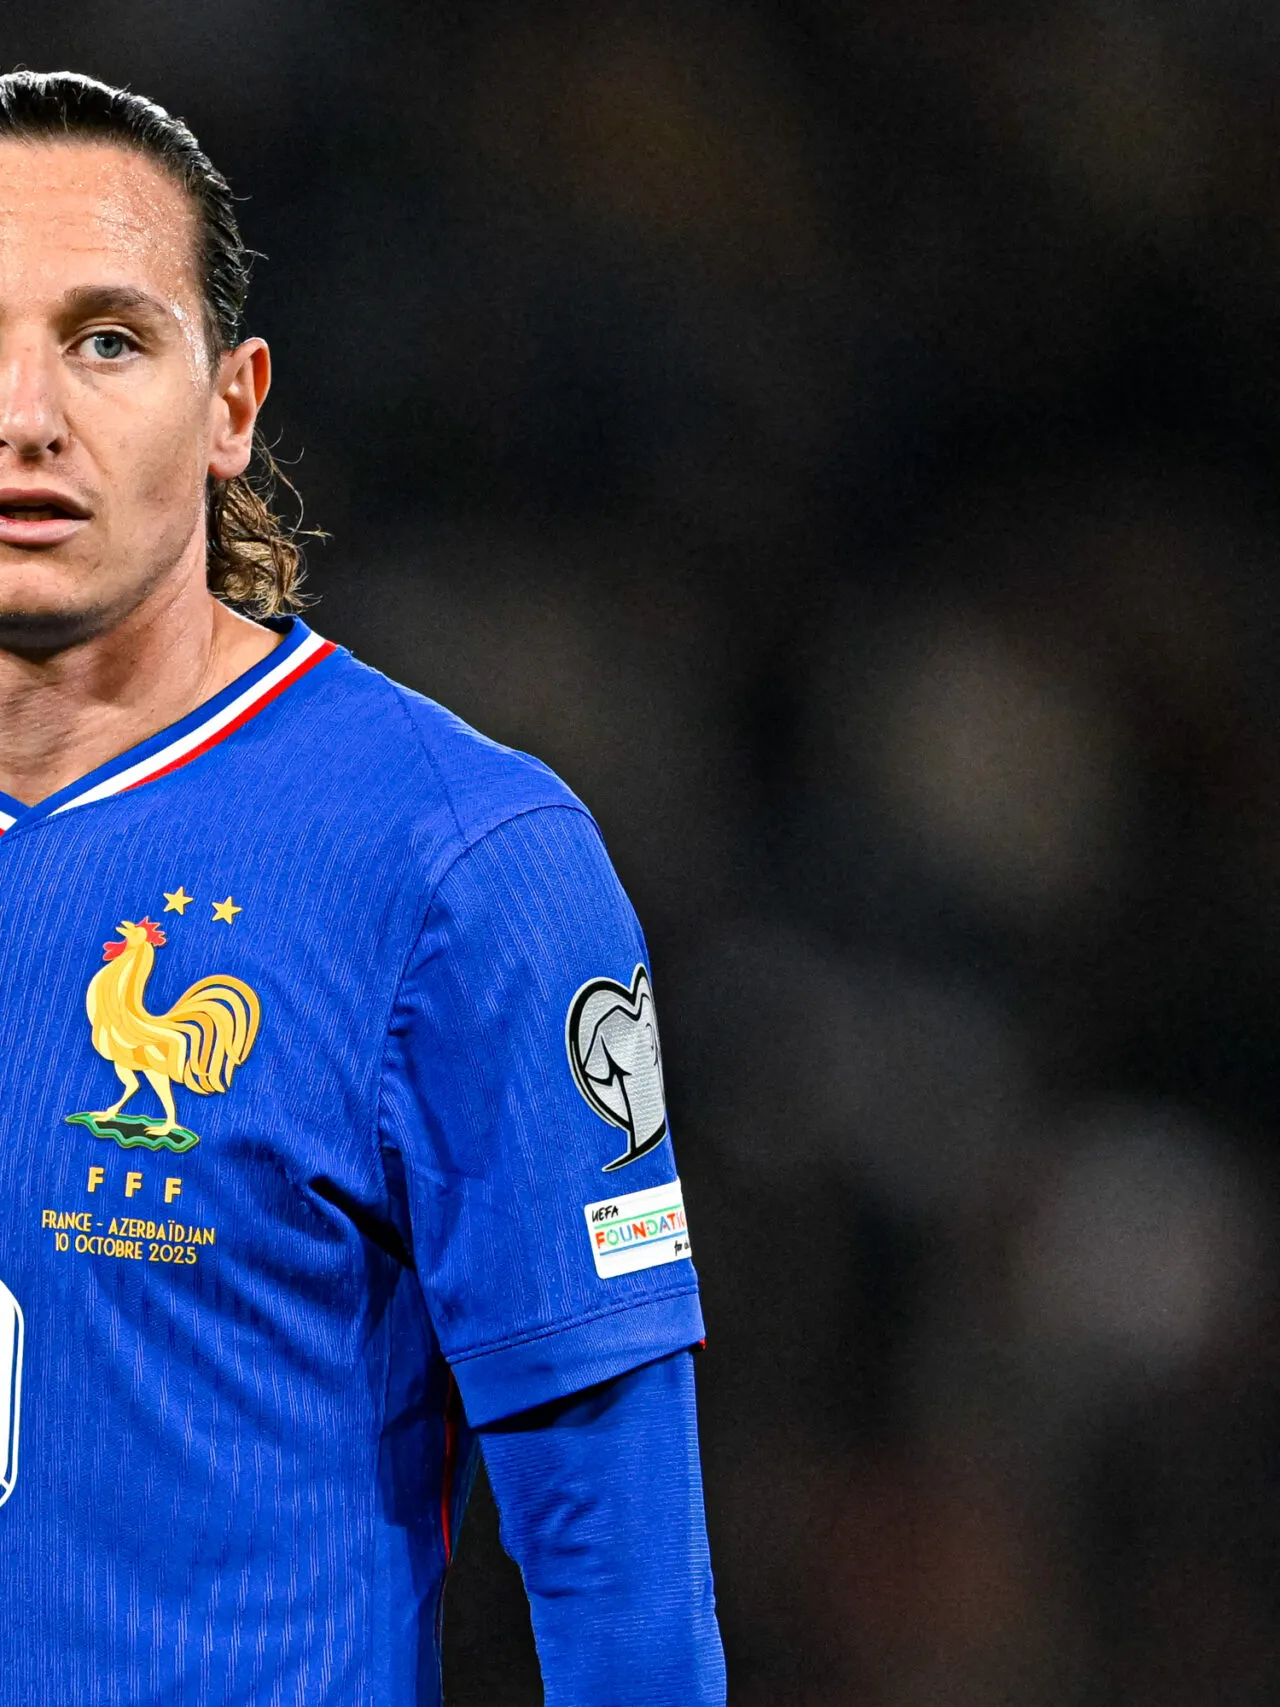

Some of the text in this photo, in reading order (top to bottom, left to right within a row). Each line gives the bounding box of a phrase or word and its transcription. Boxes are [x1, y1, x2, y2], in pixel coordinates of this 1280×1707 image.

[87, 1166, 182, 1203] F F F
[41, 1209, 92, 1232] FRANCE
[108, 1217, 216, 1245] AZERBAÏDJAN
[592, 1205, 619, 1222] UEFA
[55, 1232, 198, 1265] 10 OCTOBRE 2025
